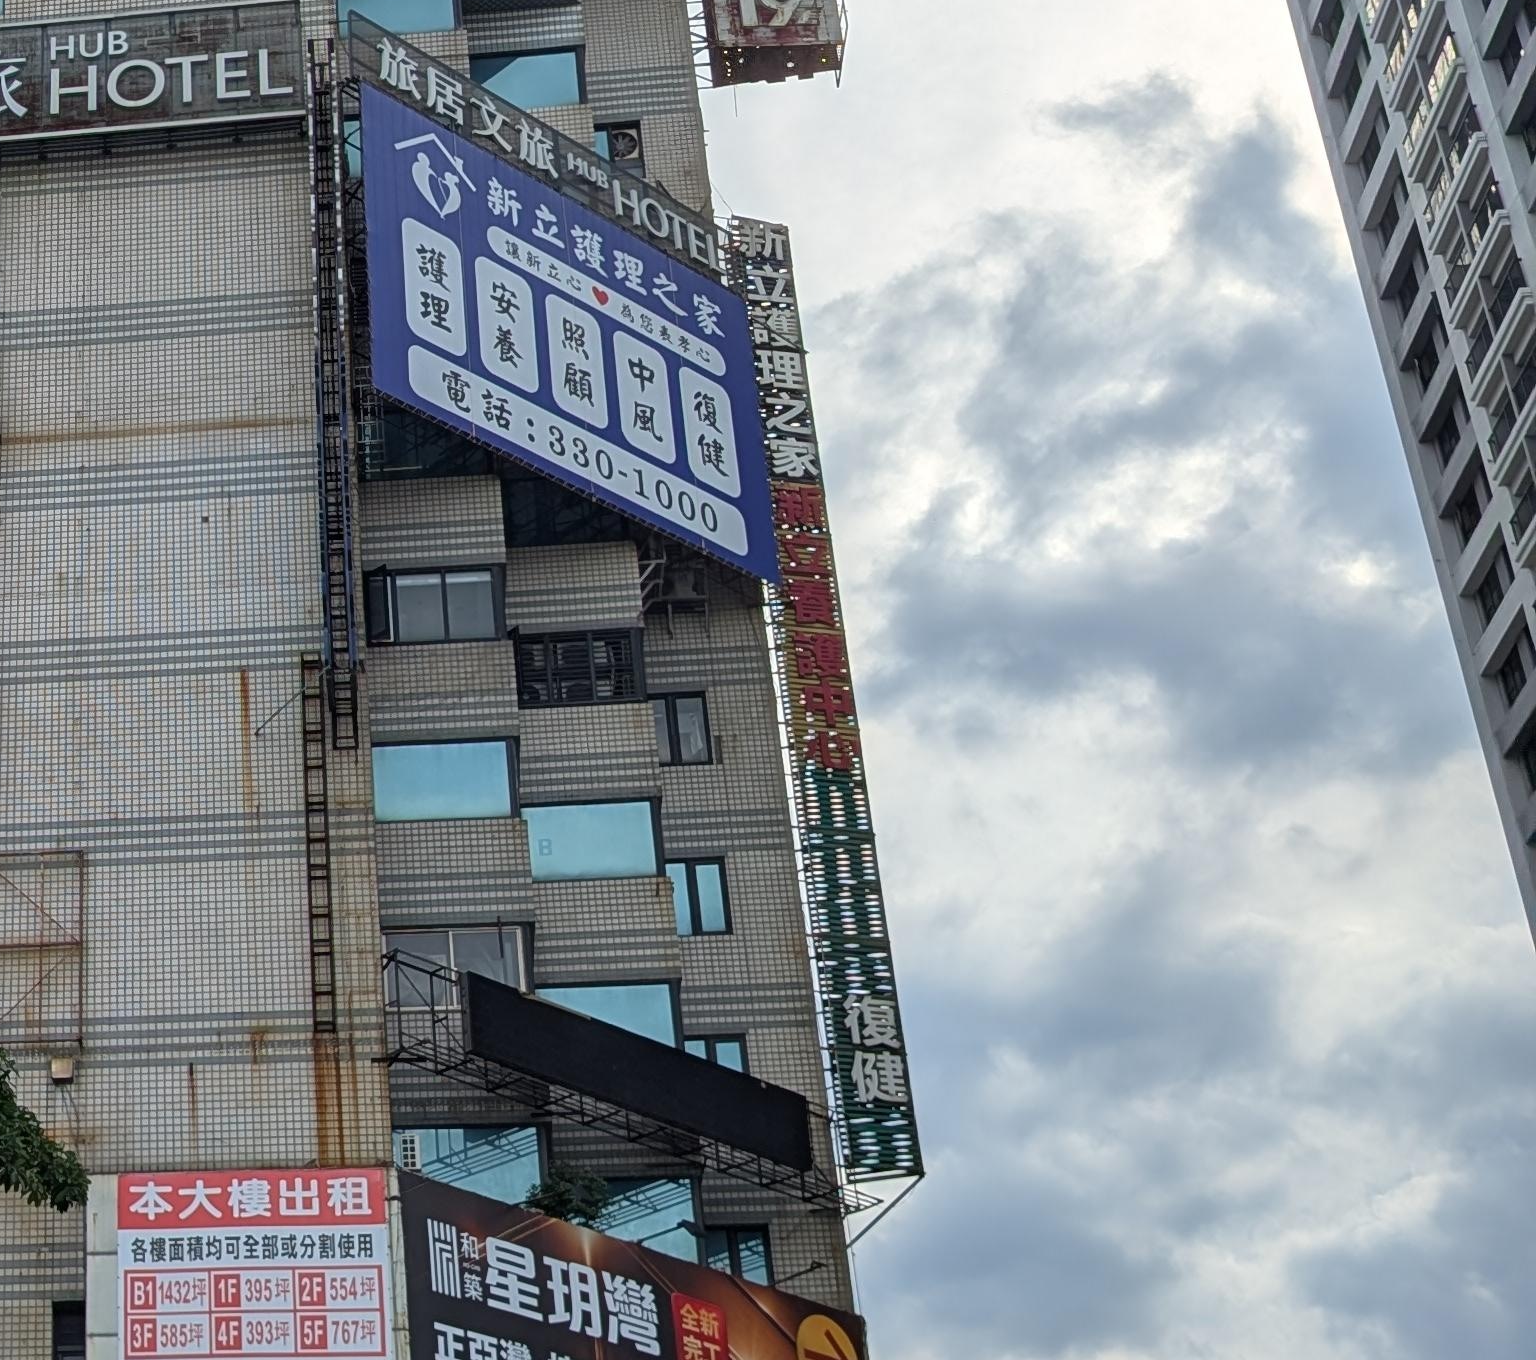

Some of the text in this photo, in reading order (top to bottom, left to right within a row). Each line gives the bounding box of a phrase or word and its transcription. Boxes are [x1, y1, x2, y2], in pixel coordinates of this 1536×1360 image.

[49, 47, 295, 117] HOTEL
[50, 30, 129, 61] HUB
[376, 36, 561, 180] 旅居文旅
[486, 176, 727, 339] 新立護理之家
[566, 151, 726, 277] HUB HOTEL
[415, 243, 453, 334] 護理
[489, 281, 524, 370] 安養
[560, 316, 596, 408] 照顧
[739, 221, 821, 479] 新立護理之家
[628, 357, 664, 443] 中風
[692, 389, 731, 479] 復健
[842, 993, 910, 1105] 復健
[129, 1177, 372, 1220] 本大樓出租
[131, 1233, 373, 1263] 各樓面積均可全部或分割使用
[134, 1275, 376, 1307] B1 1432坪 1F 395坪 2F 554坪
[133, 1319, 376, 1348] 3F 585坪 4F 393坪 5F 767坪
[485, 1236, 662, 1357] 星玥灣
[679, 1302, 720, 1340] 全新
